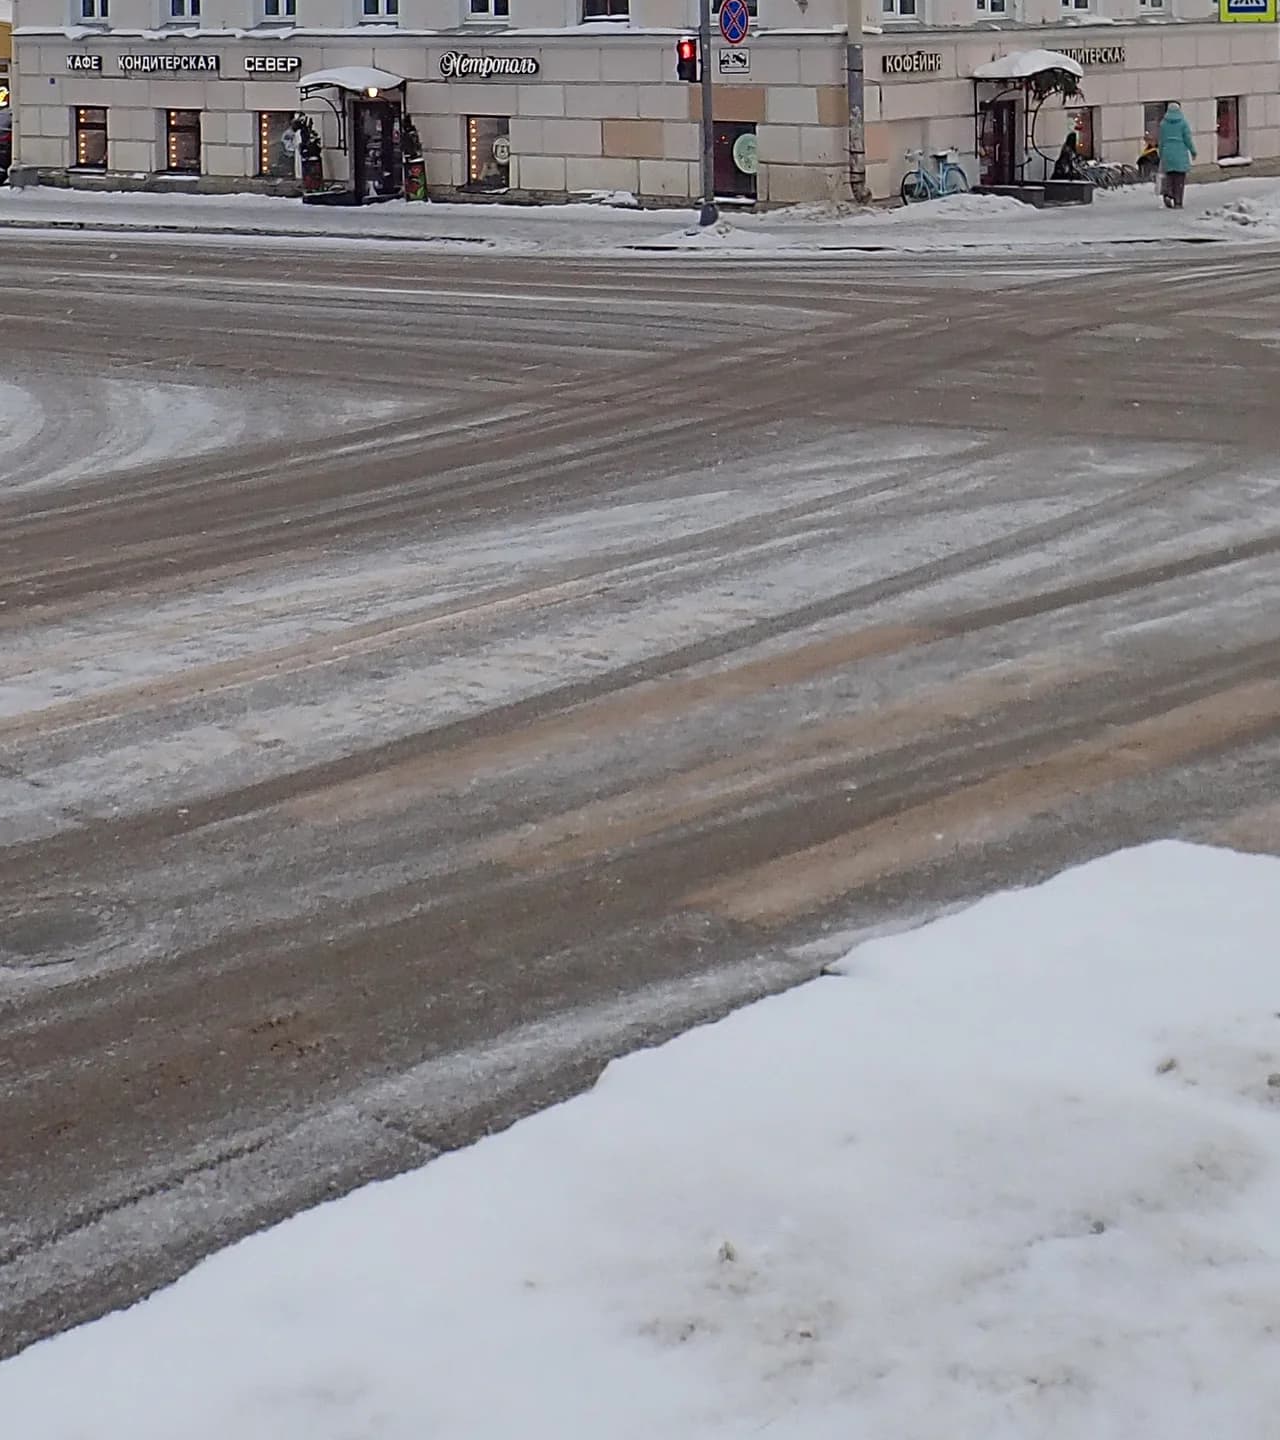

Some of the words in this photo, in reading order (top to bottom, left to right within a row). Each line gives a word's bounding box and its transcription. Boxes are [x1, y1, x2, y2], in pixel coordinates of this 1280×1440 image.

[66, 55, 100, 70] КАФЕ
[117, 55, 217, 72] КОНДИТЕРСКАЯ
[244, 57, 299, 72] СЕВЕР
[439, 51, 537, 78] Метрополь
[885, 53, 942, 72] КОФЕЙНЯ
